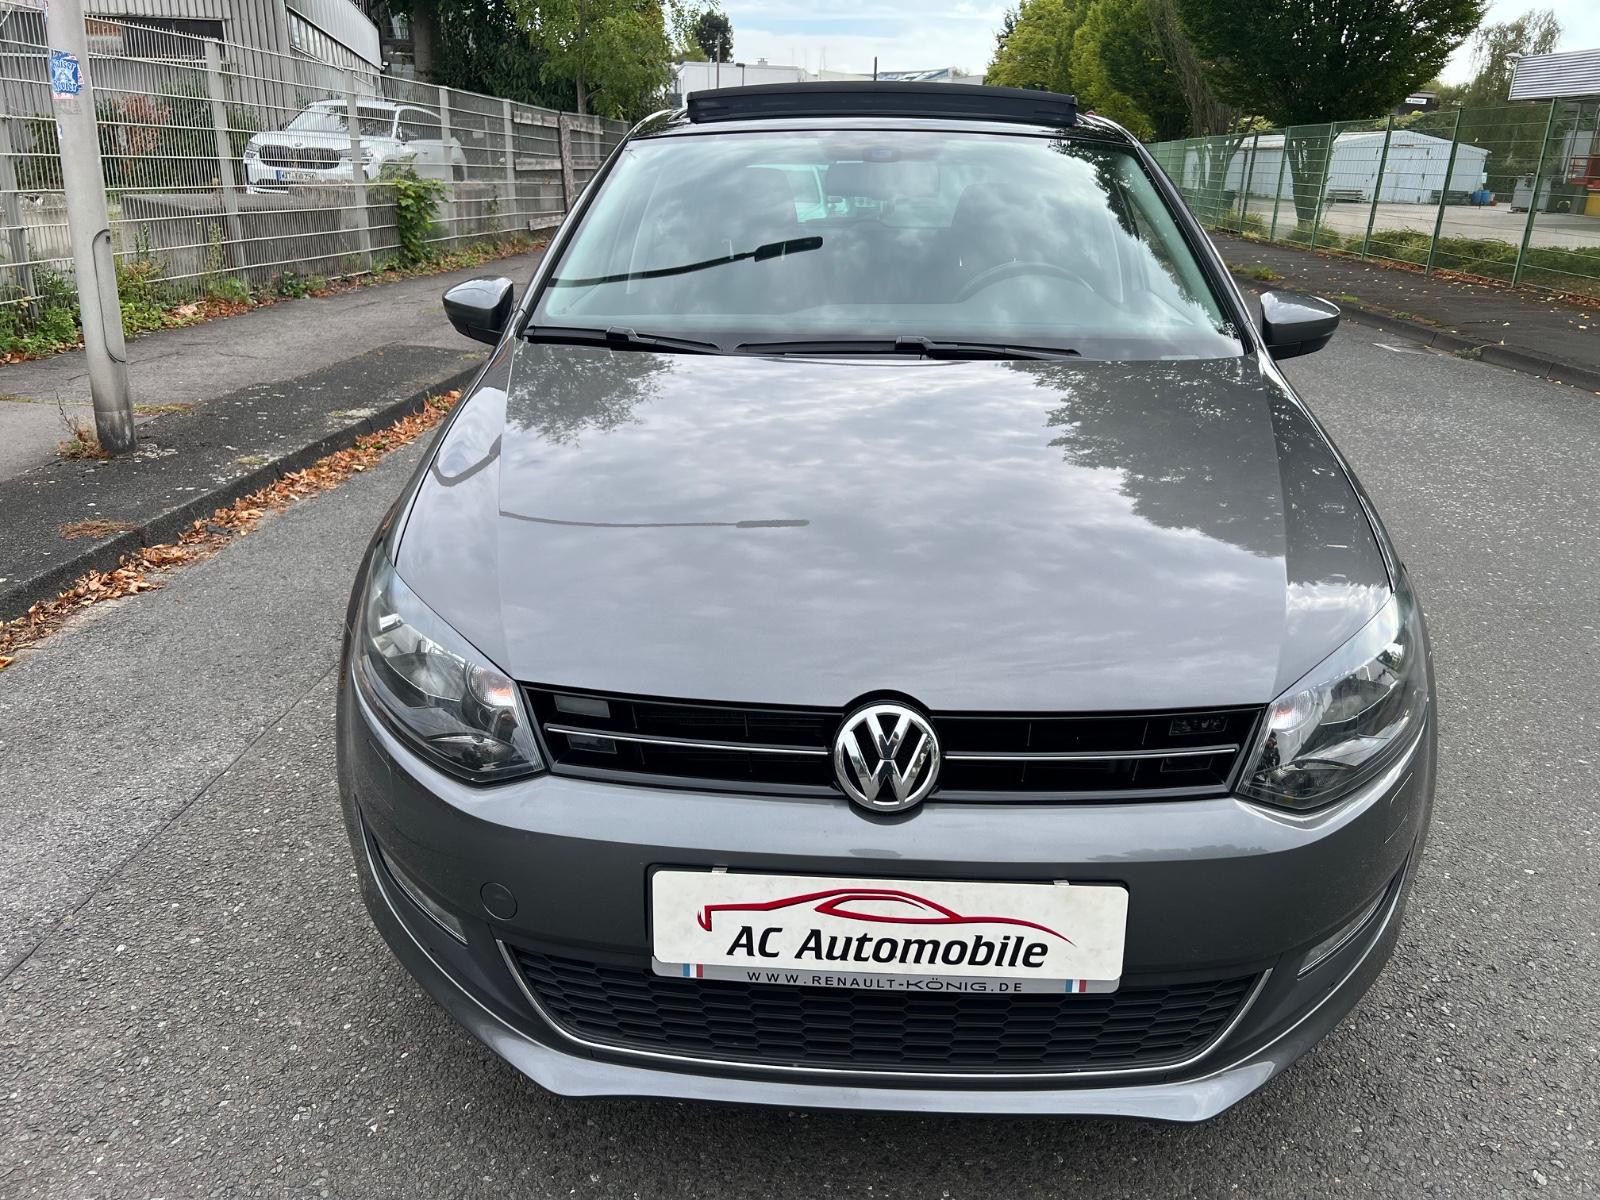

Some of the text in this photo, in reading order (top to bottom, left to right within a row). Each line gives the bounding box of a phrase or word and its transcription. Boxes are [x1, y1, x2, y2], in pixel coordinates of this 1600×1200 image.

[726, 925, 1048, 968] AC Automobile
[747, 971, 1023, 992] WWW.RENAULT-KÖNIG.DE
